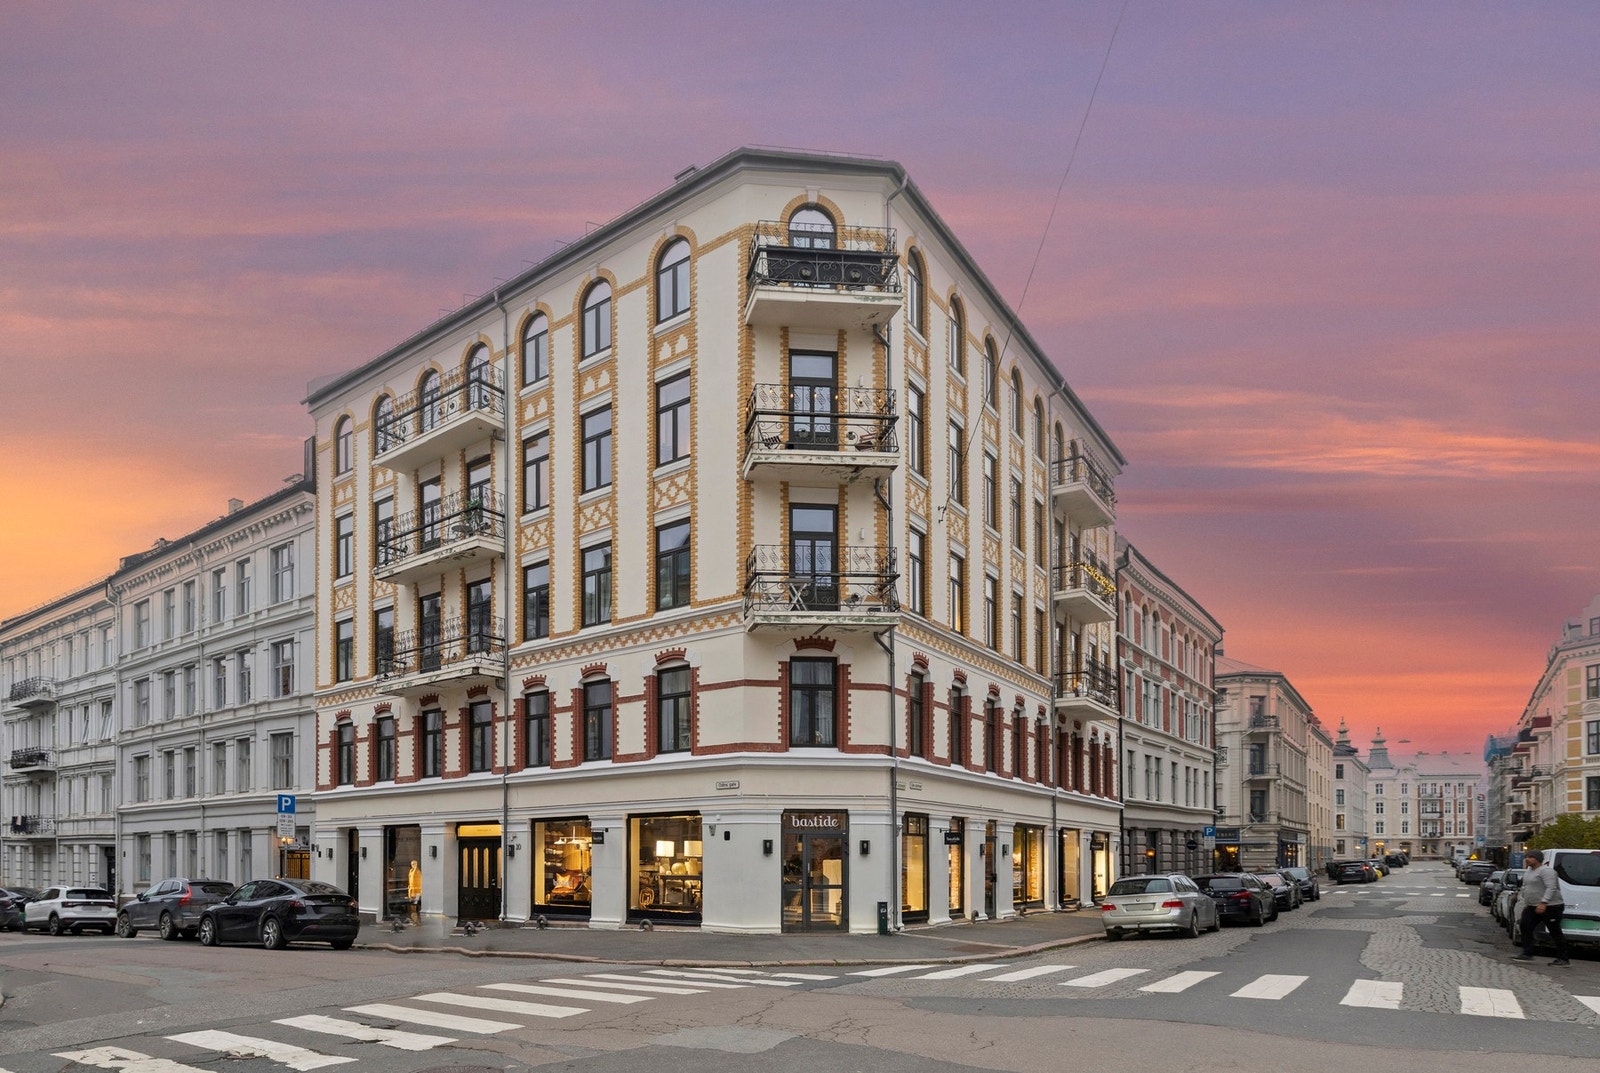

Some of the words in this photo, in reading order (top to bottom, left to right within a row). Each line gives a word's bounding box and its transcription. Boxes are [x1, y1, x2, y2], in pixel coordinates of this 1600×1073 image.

[281, 797, 292, 811] P
[791, 815, 839, 828] bastide
[1206, 827, 1213, 836] P
